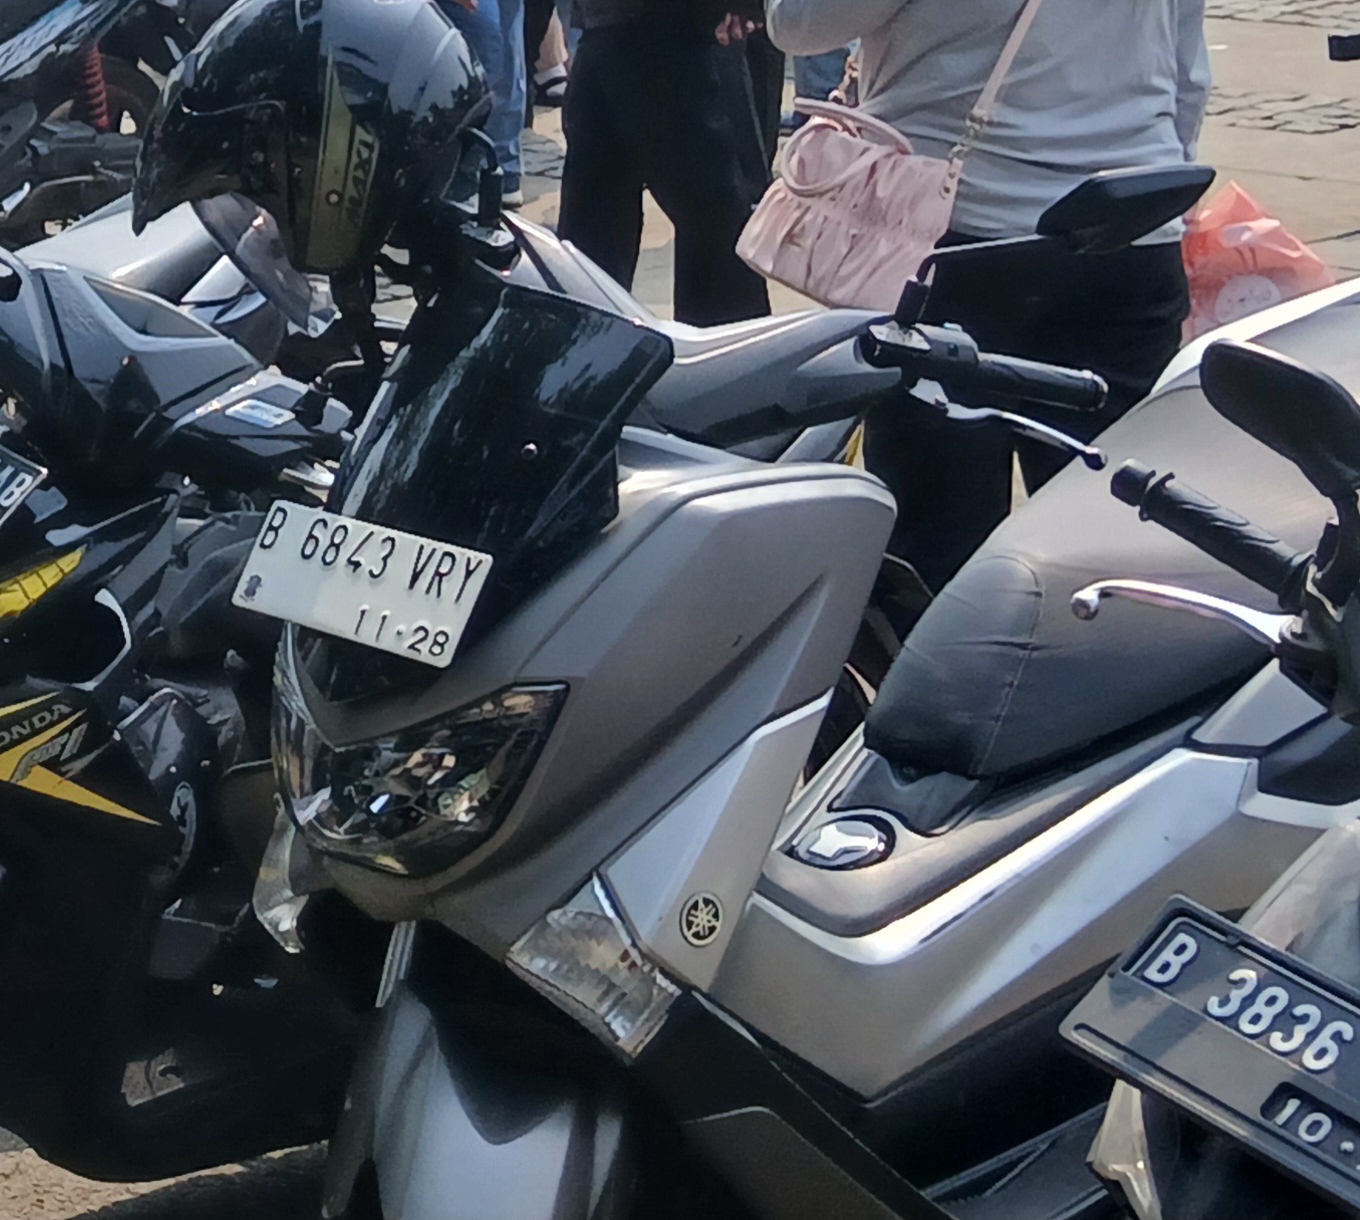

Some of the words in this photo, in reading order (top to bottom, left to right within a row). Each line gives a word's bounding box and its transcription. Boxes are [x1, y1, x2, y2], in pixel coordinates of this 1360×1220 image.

[259, 506, 288, 549] B
[300, 518, 396, 579] 6843
[408, 544, 483, 603] VRY
[1144, 932, 1198, 983] B
[1207, 968, 1354, 1070] 3836
